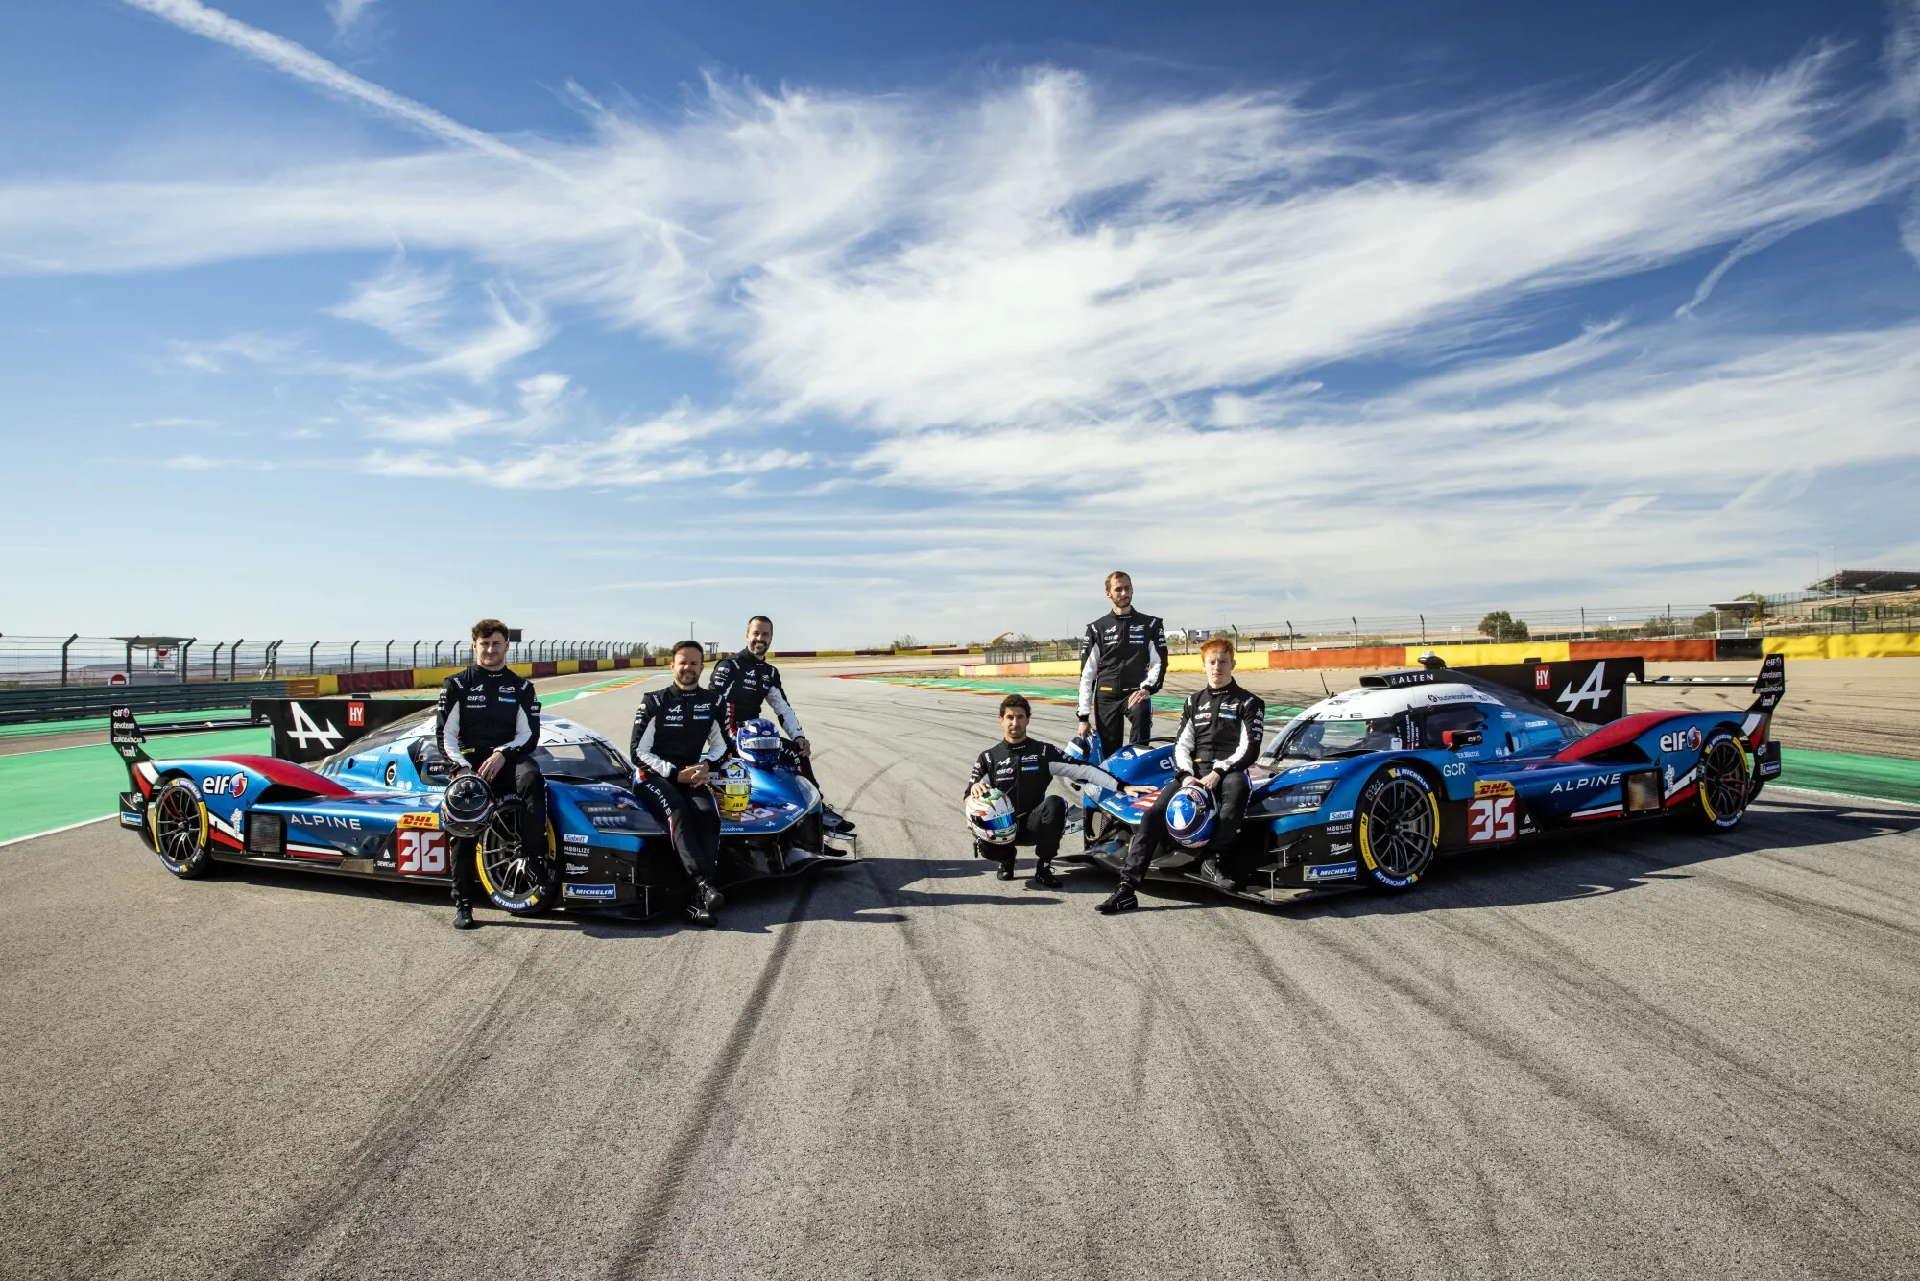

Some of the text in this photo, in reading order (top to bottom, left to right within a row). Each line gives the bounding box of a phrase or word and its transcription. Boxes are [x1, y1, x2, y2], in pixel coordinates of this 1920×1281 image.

[1399, 673, 1434, 684] ALTEN
[1536, 670, 1549, 686] HY
[349, 706, 363, 722] HY
[1660, 730, 1686, 752] elf
[1443, 762, 1466, 777] GCR
[203, 775, 230, 794] elf
[1550, 773, 1622, 794] ALPINE
[646, 783, 672, 816] ALPINE
[290, 813, 362, 831] ALPINE
[402, 814, 434, 827] DHL
[1470, 797, 1515, 841] 35
[400, 831, 446, 872] 36
[1320, 866, 1357, 876] MICHELIN
[575, 888, 614, 896] MICHELIN
